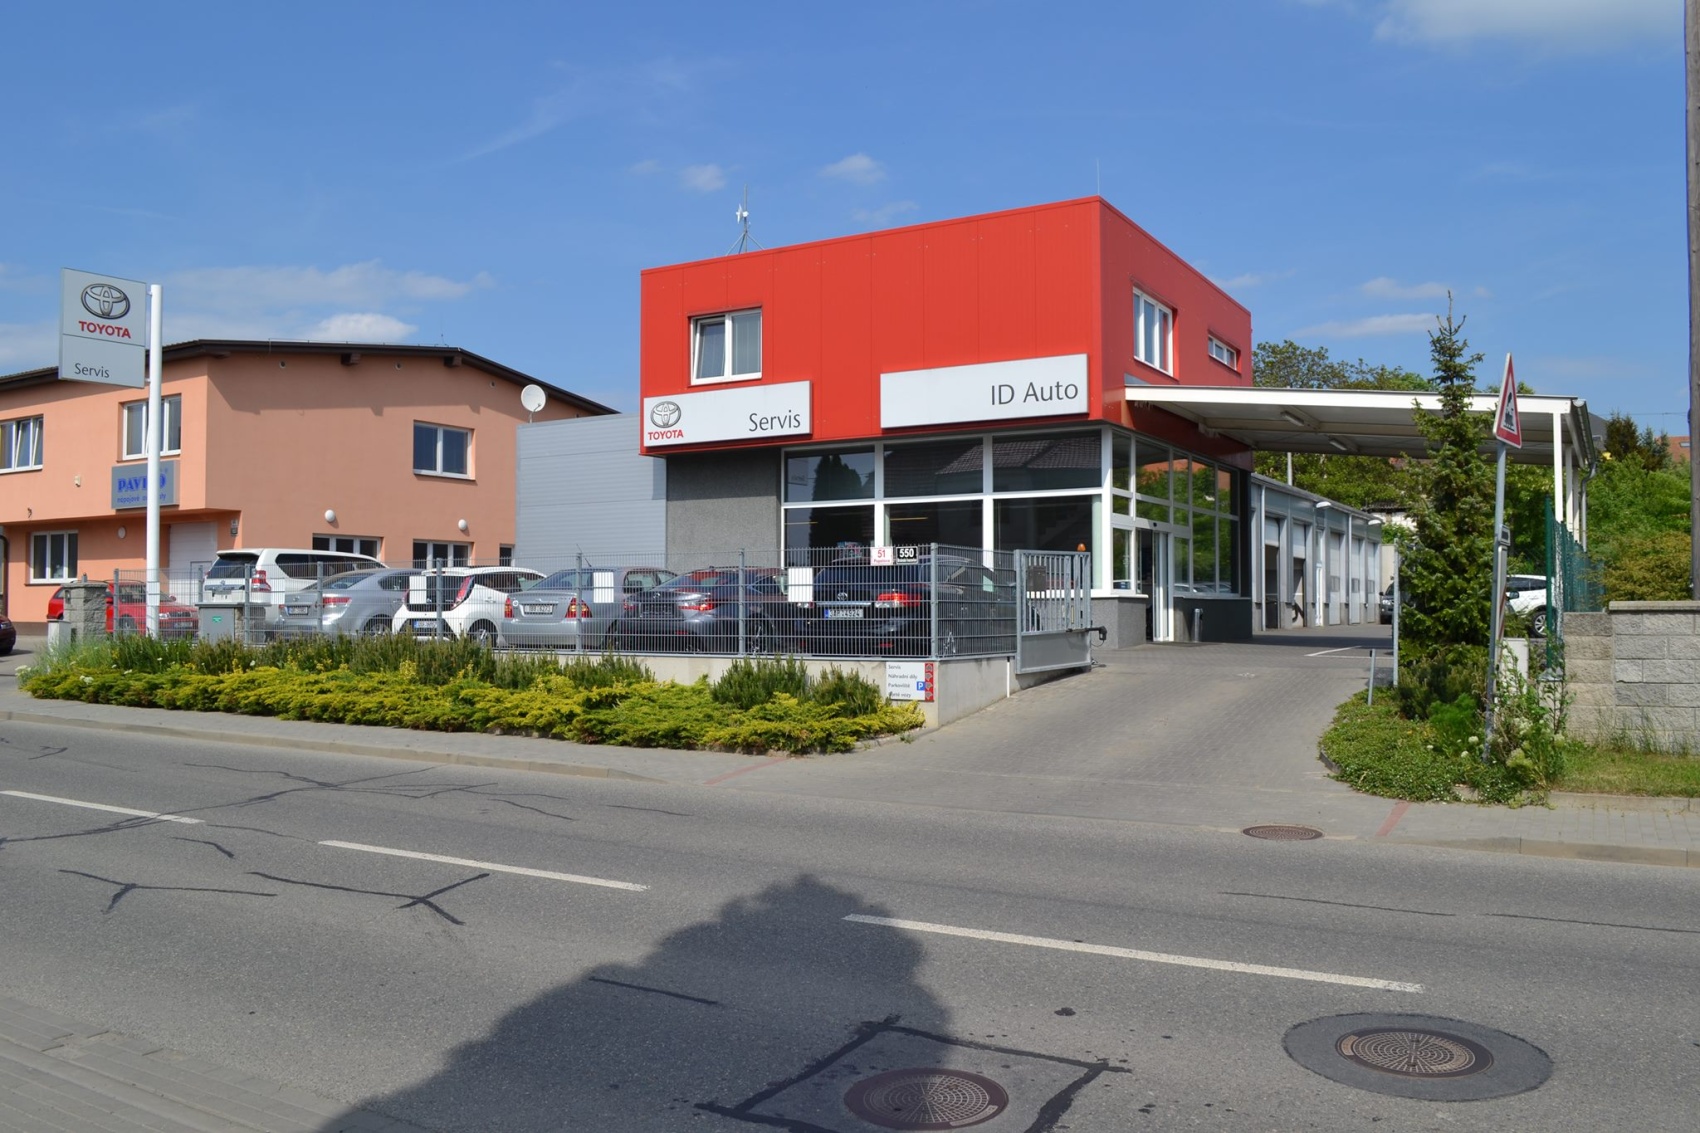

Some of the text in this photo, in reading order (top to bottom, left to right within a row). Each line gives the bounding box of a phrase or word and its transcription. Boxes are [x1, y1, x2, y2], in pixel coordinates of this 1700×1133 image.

[78, 320, 131, 339] TOYOTA
[74, 362, 110, 378] Servis
[991, 381, 1079, 406] ID Auto
[749, 409, 801, 432] Servis
[647, 429, 684, 441] TOYOTA
[877, 549, 886, 558] 51
[899, 548, 915, 558] 550
[918, 682, 924, 690] P
